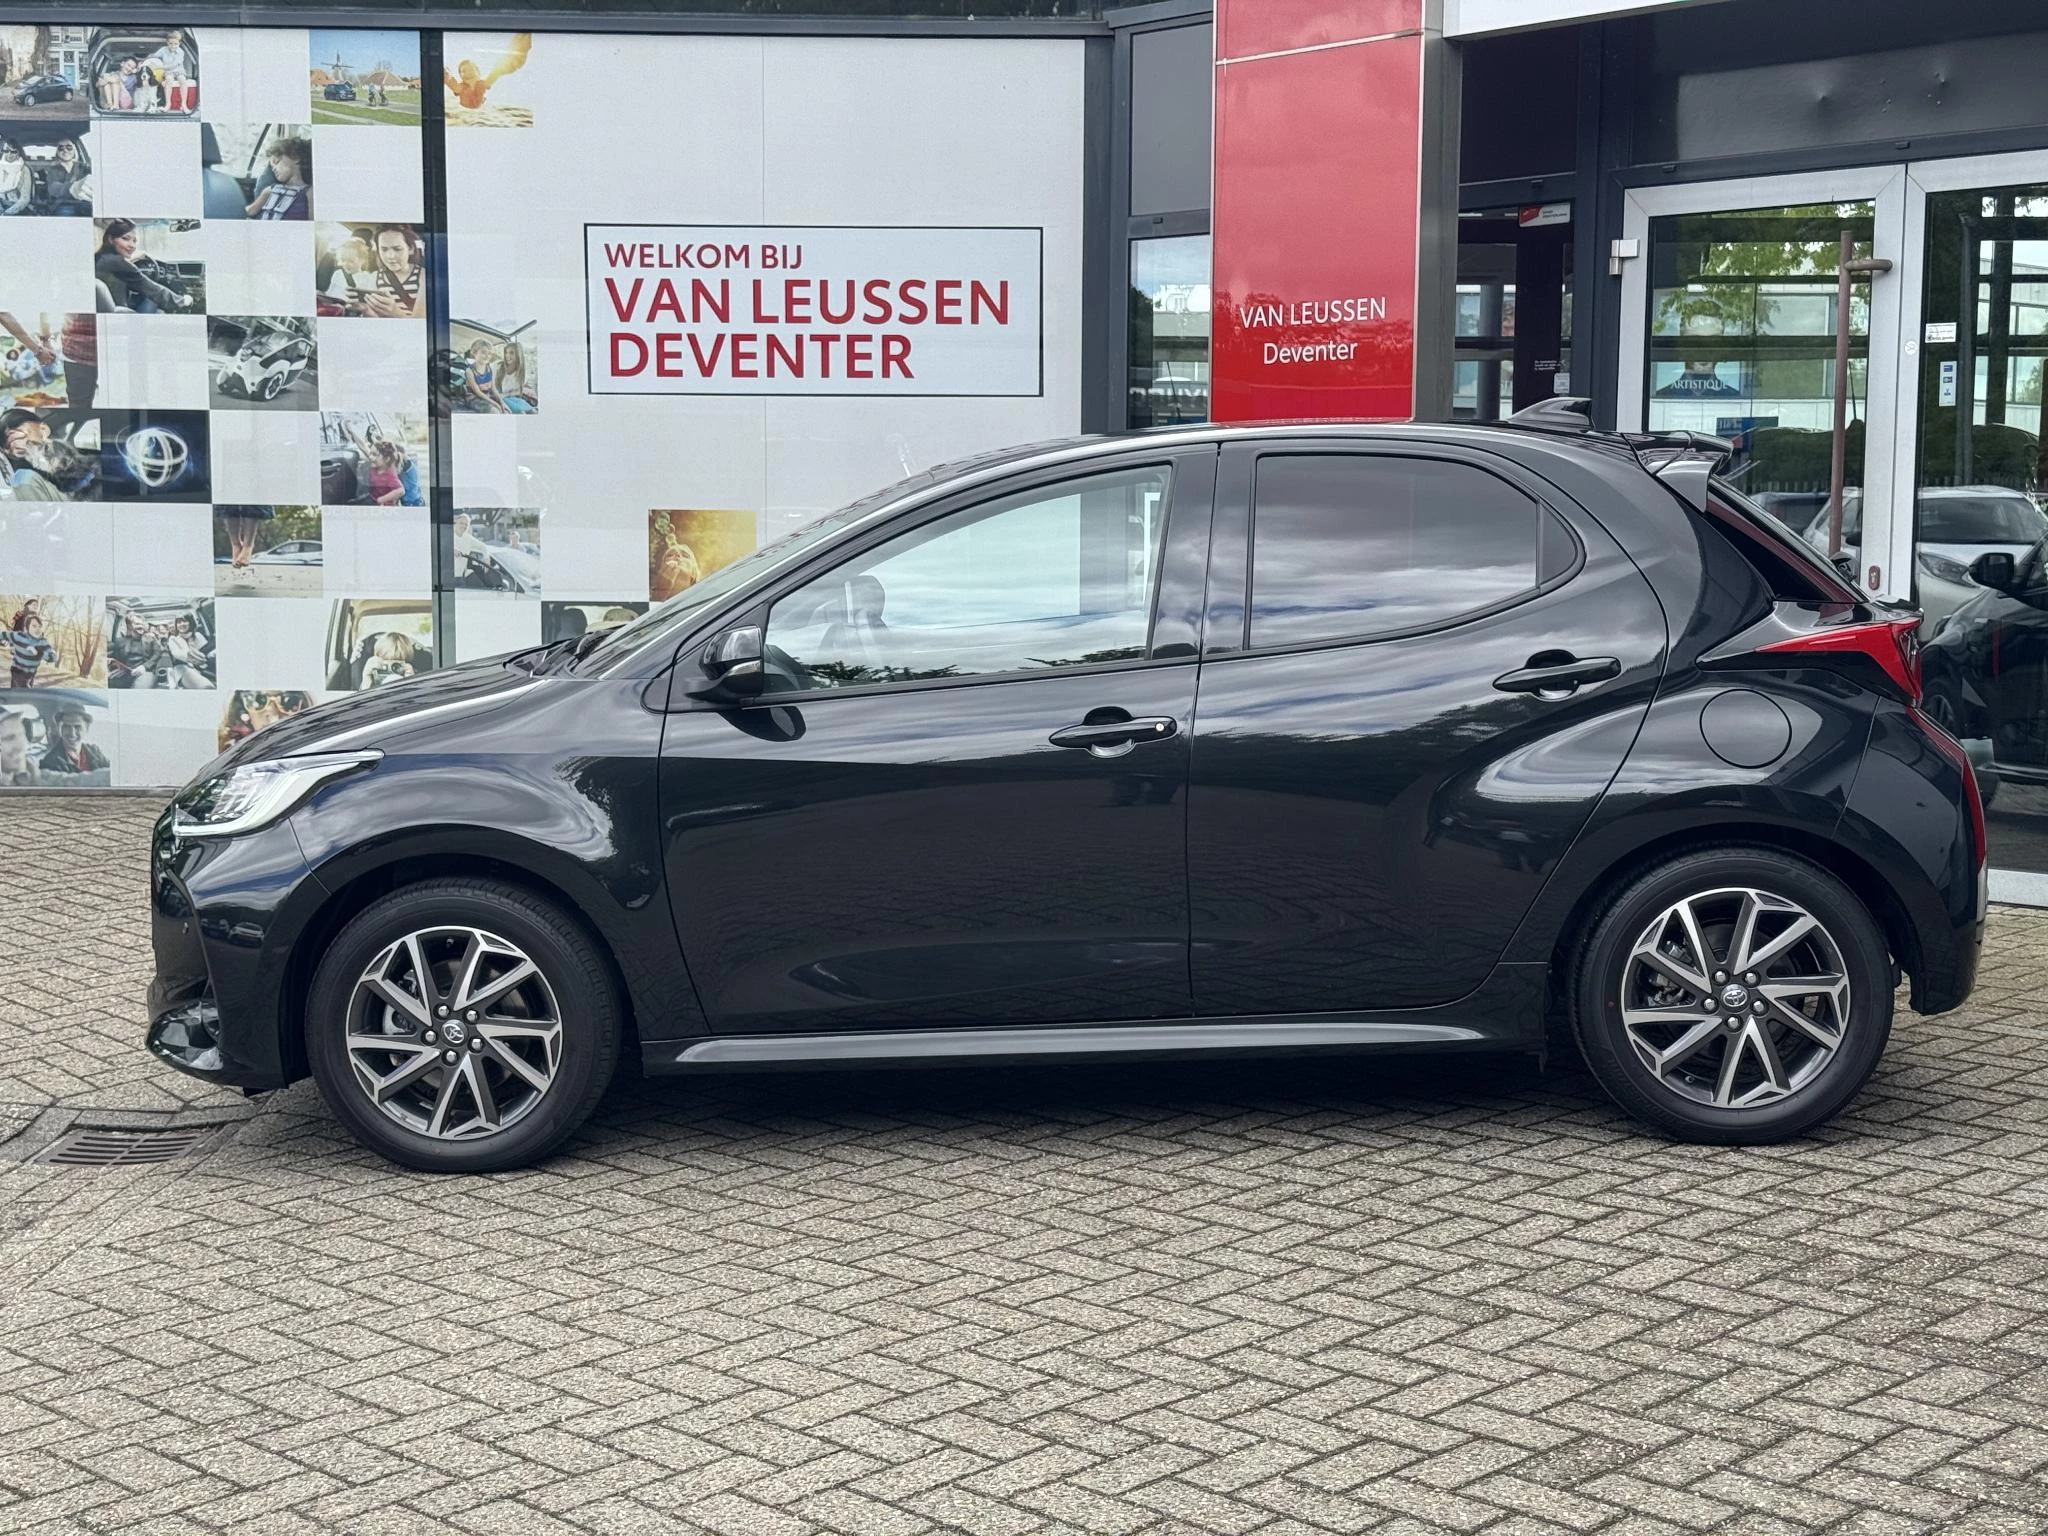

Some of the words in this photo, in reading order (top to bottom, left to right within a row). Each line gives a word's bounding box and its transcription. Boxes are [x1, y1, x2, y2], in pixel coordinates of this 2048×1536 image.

[603, 243, 750, 269] WELKOM
[761, 244, 803, 269] BIJ
[605, 278, 730, 323] VAN
[752, 279, 1009, 325] LEUSSEN
[1239, 304, 1283, 328] VAN
[1290, 296, 1386, 325] LEUSSEN
[609, 332, 914, 379] DEVENTER
[1263, 341, 1358, 365] Deventer
